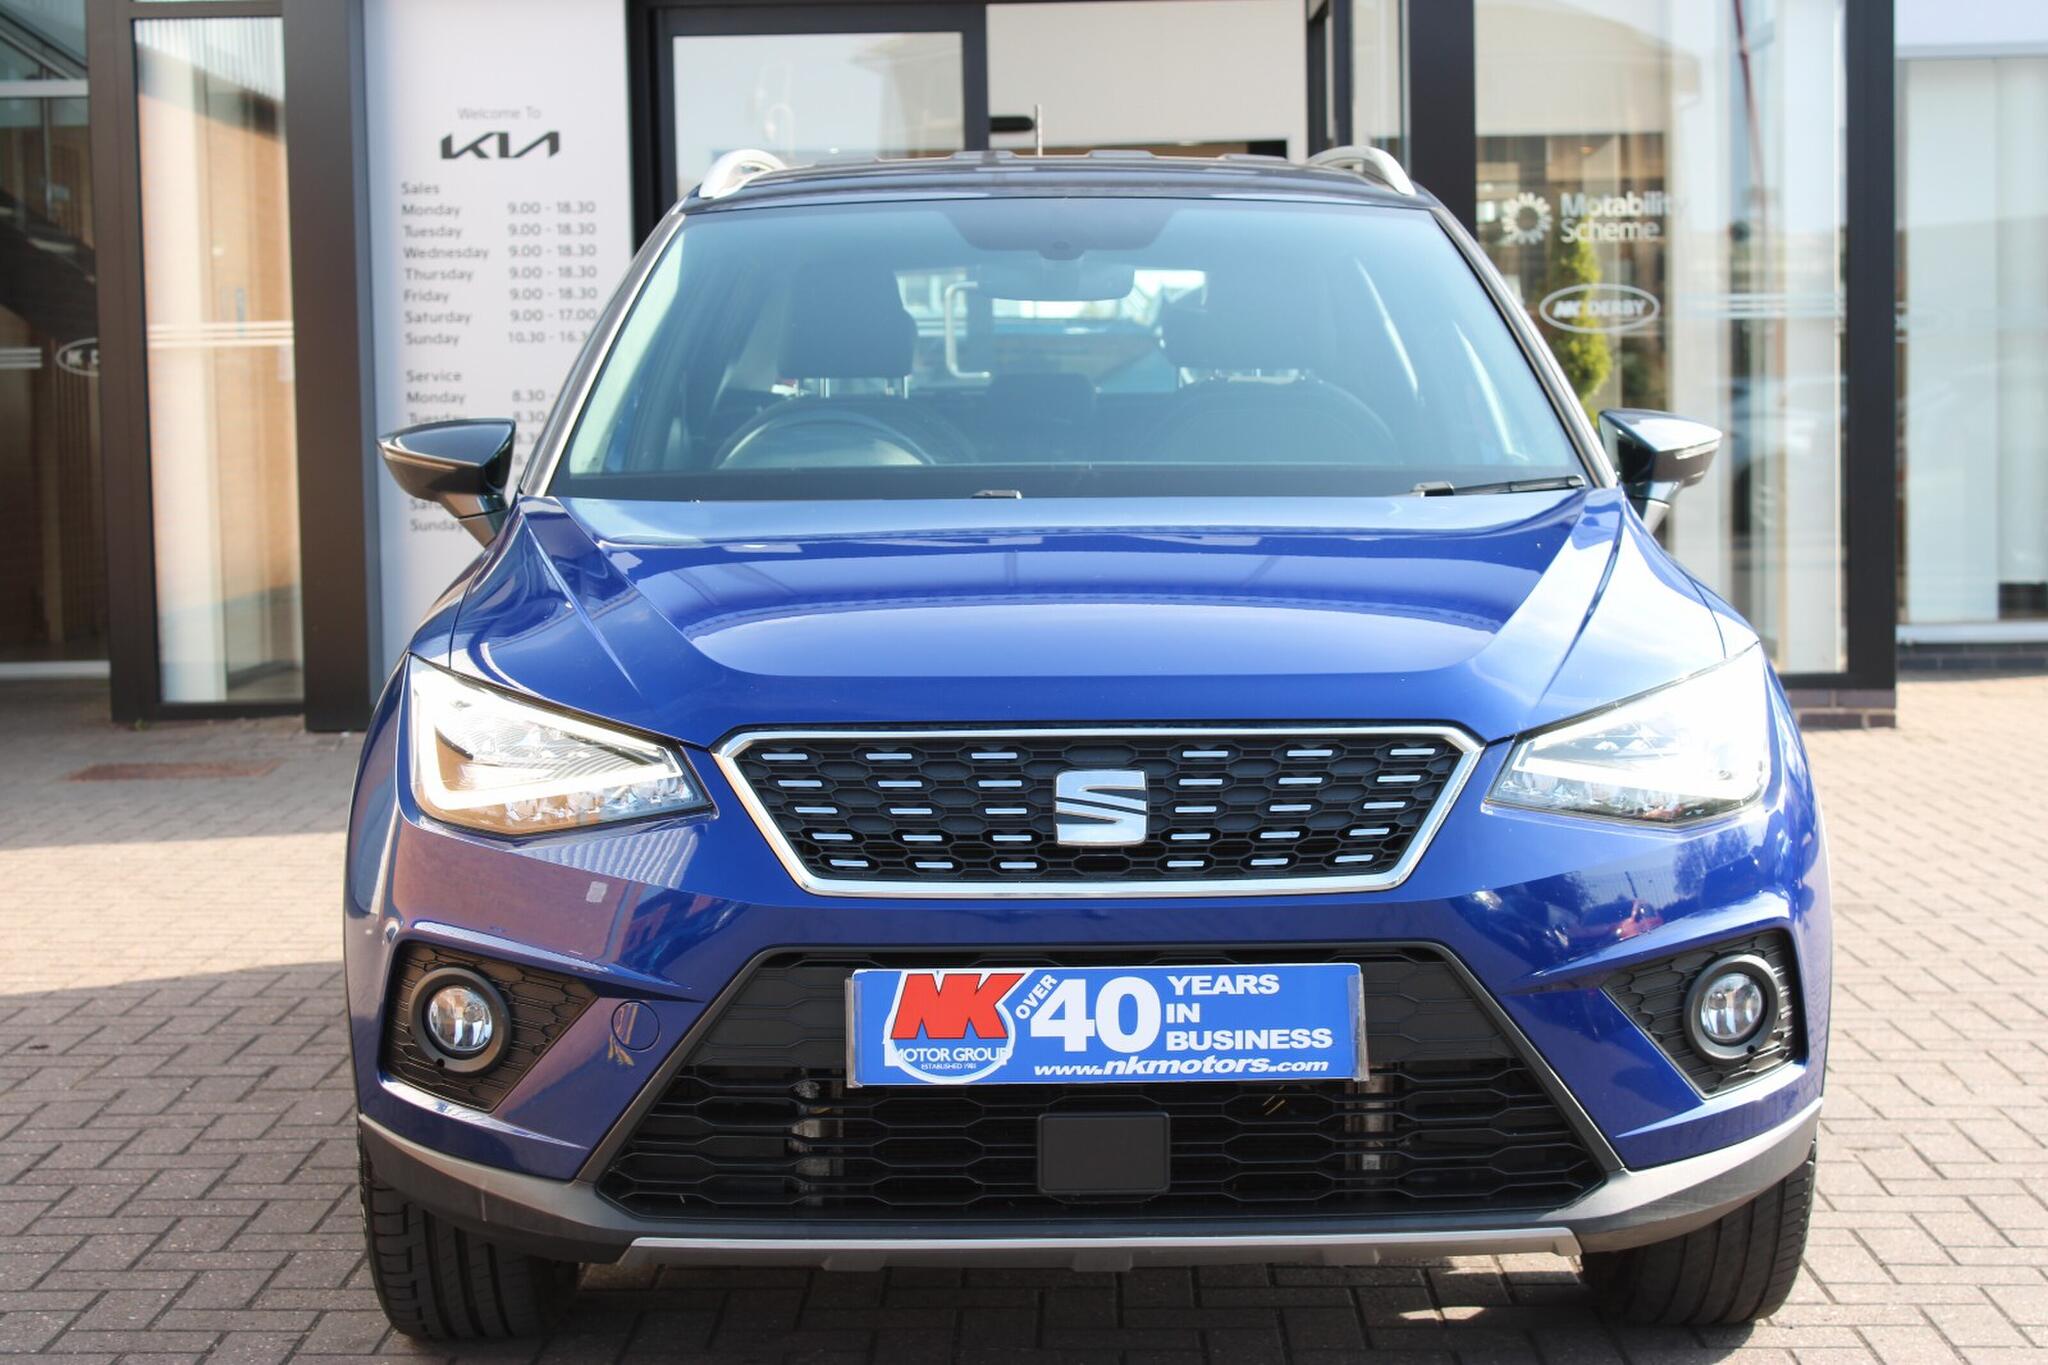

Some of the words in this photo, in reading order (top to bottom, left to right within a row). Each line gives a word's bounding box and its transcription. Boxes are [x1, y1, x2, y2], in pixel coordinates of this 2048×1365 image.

[458, 107, 521, 121] Welcome
[526, 106, 542, 120] To
[440, 131, 560, 160] KIA
[402, 182, 439, 196] Sales
[402, 204, 460, 219] Monday
[507, 202, 541, 215] 9.00
[557, 201, 596, 215] 18.30
[404, 225, 462, 241] Tuesday
[508, 223, 541, 236] 9.00
[557, 222, 596, 236] 18.30
[1560, 218, 1660, 243] Scheme
[403, 247, 489, 262] Wednesday
[508, 244, 542, 258] 9.00
[558, 243, 597, 257] 18.30
[404, 268, 474, 284] Thursday
[509, 266, 543, 280] 9.00
[558, 264, 597, 278] 18.30
[404, 289, 450, 305] Friday
[510, 287, 543, 301] 9.00
[558, 286, 598, 300] 18.30
[405, 311, 471, 327] Saturday
[511, 308, 543, 322] 9.00
[405, 332, 460, 347] Sunday
[508, 331, 545, 344] 10.30
[407, 370, 462, 383] Service
[407, 392, 466, 406] Monday
[512, 389, 545, 403] 8.30
[1167, 975, 1280, 996] YEARS
[890, 973, 1026, 1040] NK
[1015, 974, 1058, 1020] OVER
[1030, 977, 1162, 1055] 40
[1167, 1002, 1200, 1024] IN
[1167, 1028, 1333, 1052] BUSINESS
[1034, 1055, 1330, 1076] www.nkmotors.com
